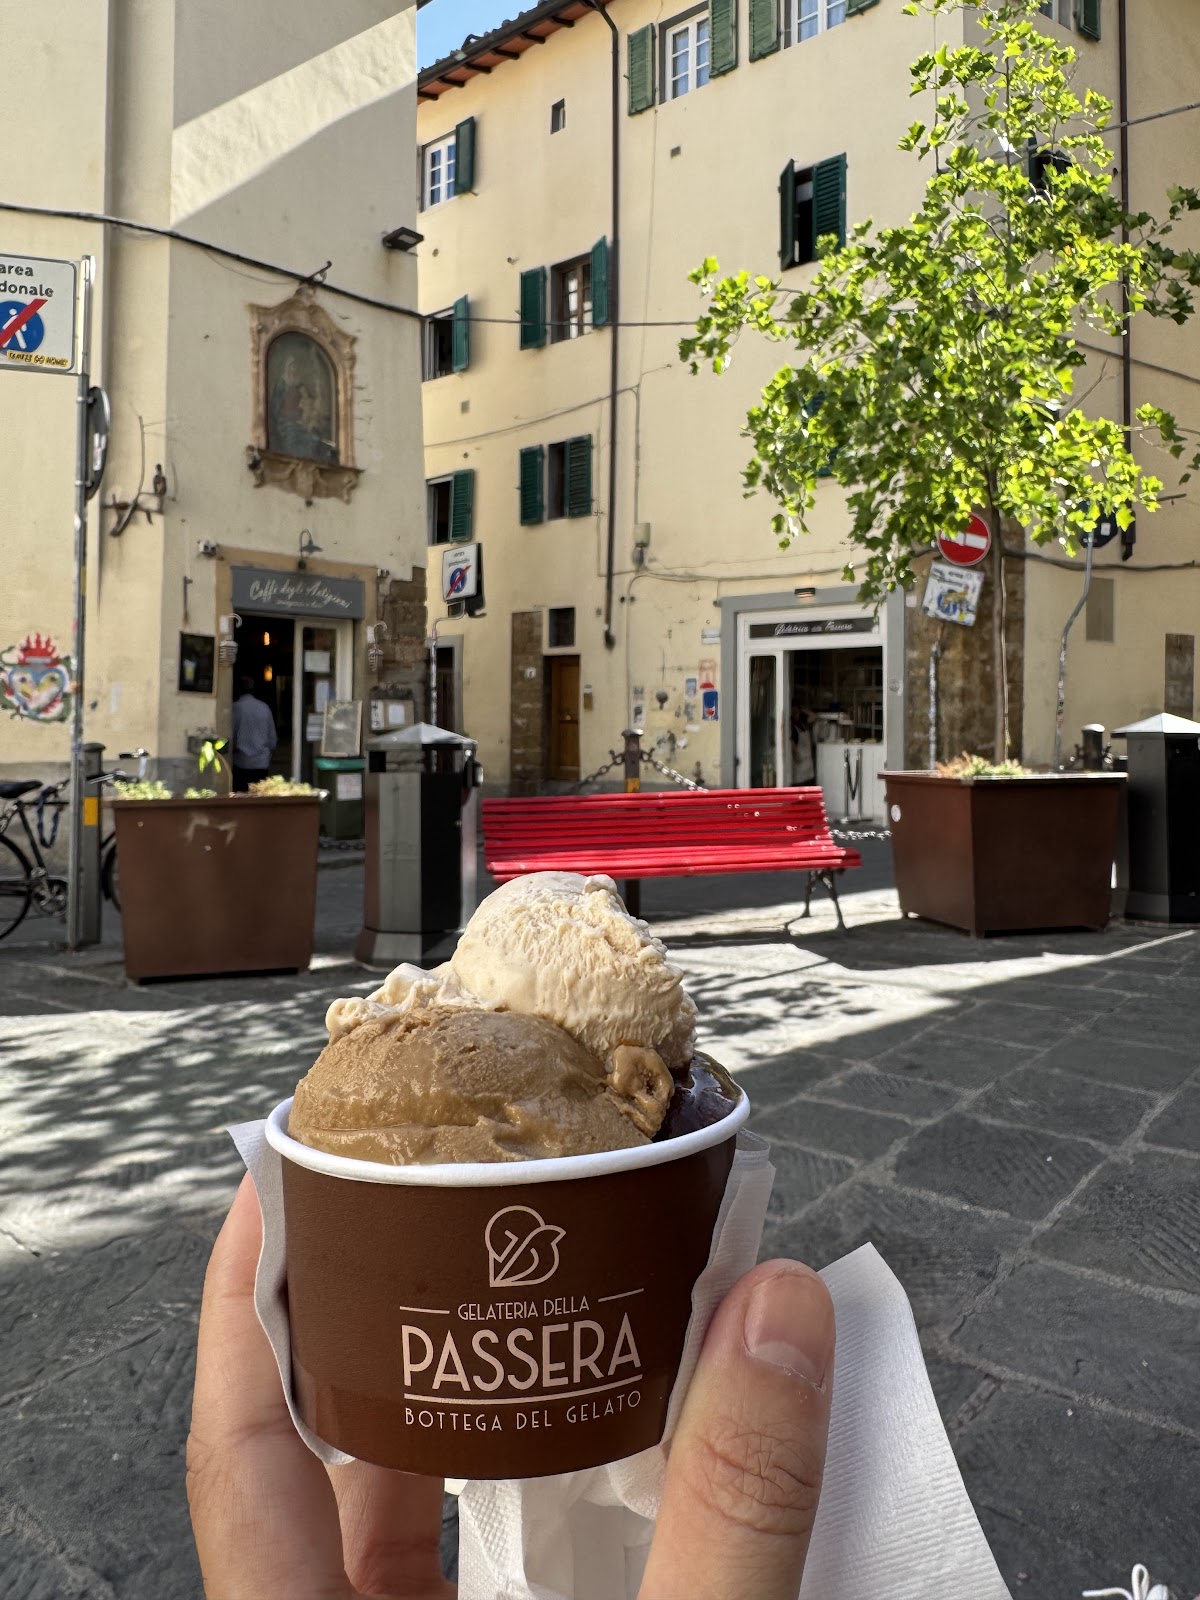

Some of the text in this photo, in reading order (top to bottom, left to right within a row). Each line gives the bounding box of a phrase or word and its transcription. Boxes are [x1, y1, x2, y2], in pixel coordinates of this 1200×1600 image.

[0, 263, 34, 277] area
[457, 1295, 590, 1321] GELATERIA DELLA
[401, 1312, 643, 1392] PASSERA
[404, 1390, 642, 1432] BOTTEGA DEL GELATO
